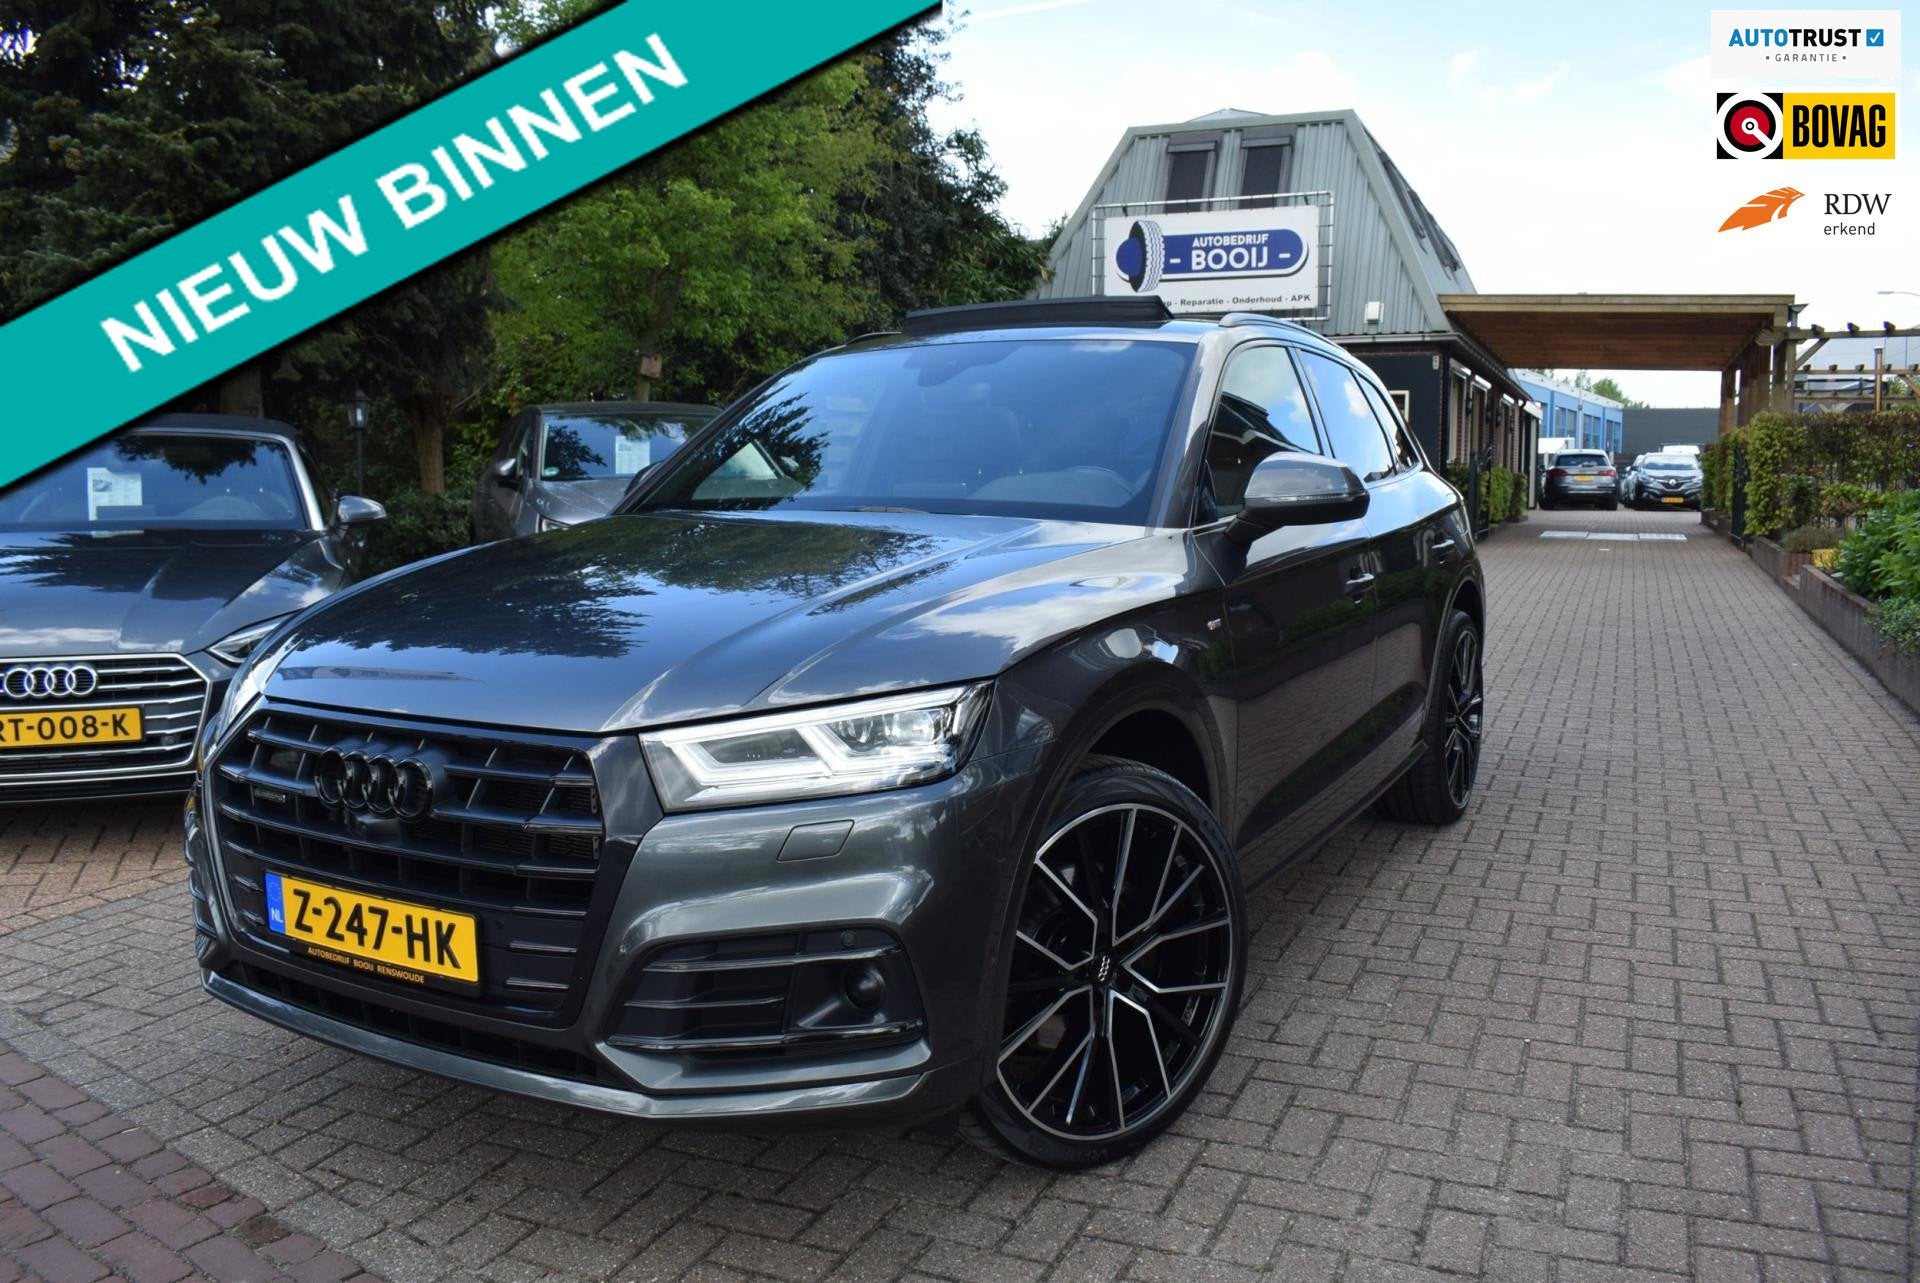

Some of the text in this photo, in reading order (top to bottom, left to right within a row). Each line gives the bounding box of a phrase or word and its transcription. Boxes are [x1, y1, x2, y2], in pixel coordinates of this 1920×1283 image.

[1192, 233, 1269, 247] AUTOBEDRIJF
[1191, 246, 1268, 270] BOOIJ
[1180, 298, 1224, 307] Reparatie
[1232, 295, 1282, 305] Onderhoud
[1290, 294, 1311, 302] APK
[270, 907, 284, 923] NL
[293, 888, 461, 969] Z-247-HK
[376, 965, 425, 984] RENSWOUDE
